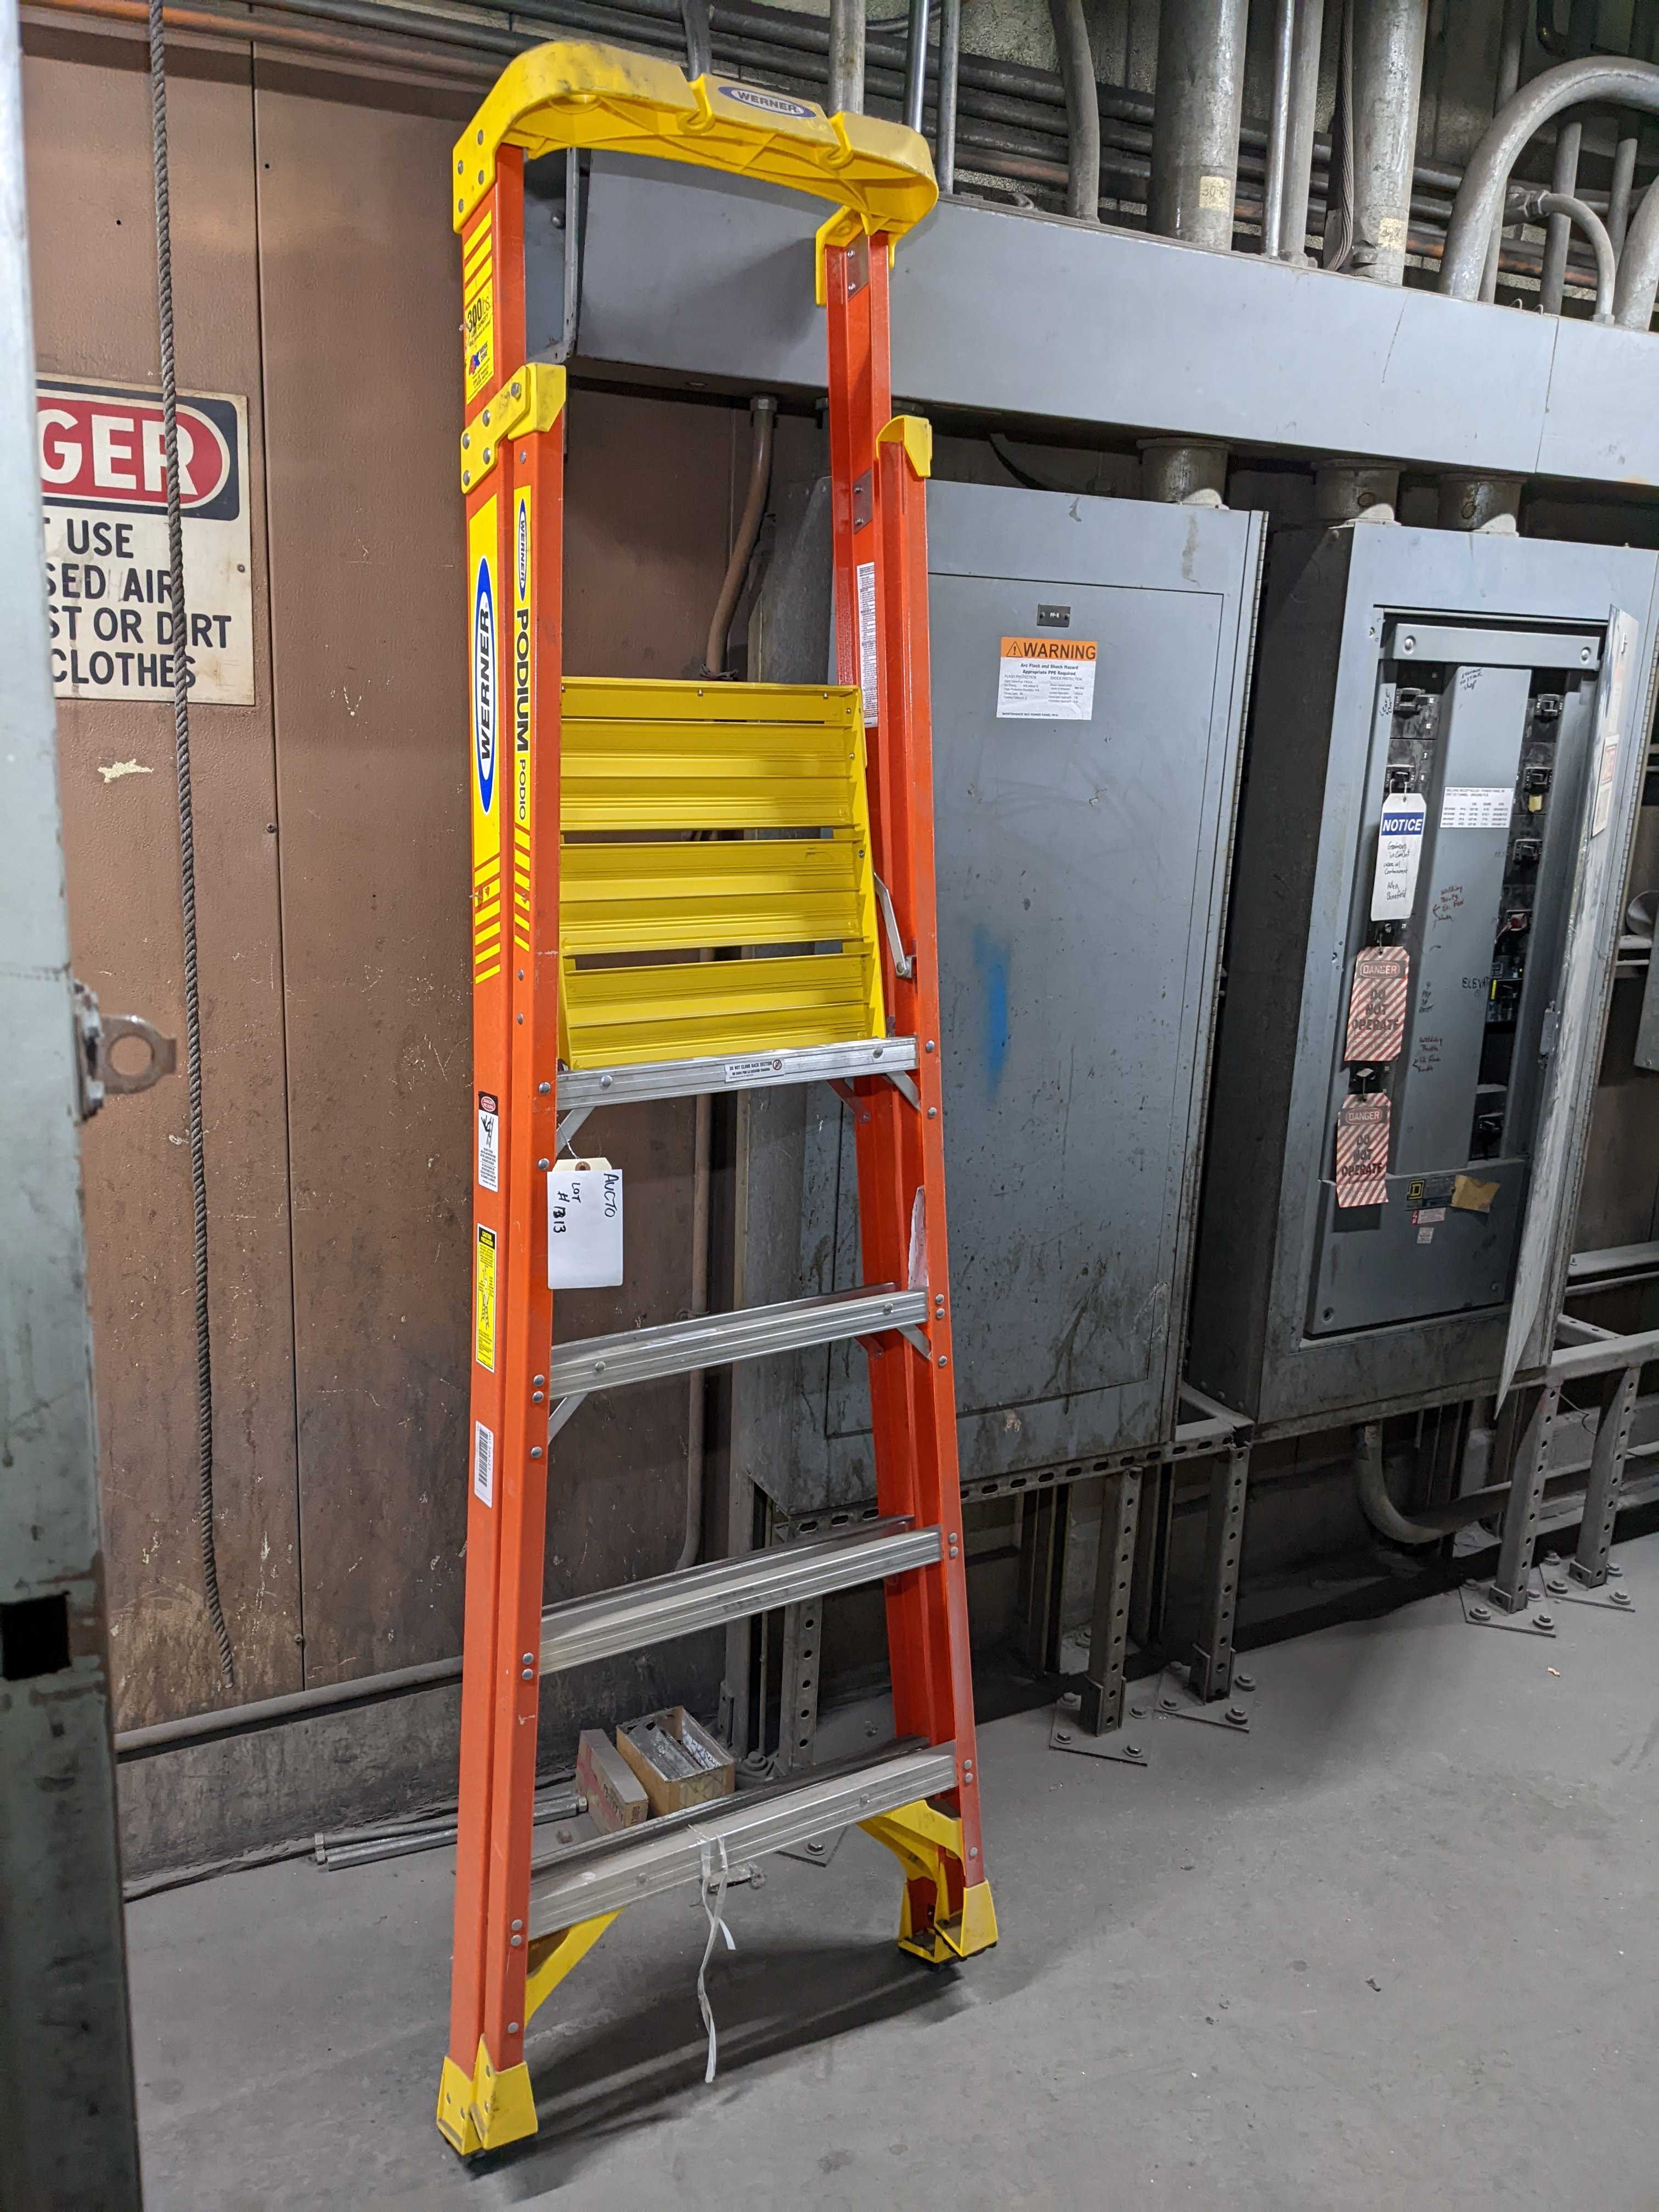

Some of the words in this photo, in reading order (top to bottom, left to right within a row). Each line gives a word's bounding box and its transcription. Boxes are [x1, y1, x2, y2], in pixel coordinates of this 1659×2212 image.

[737, 91, 798, 113] WERNER
[37, 409, 198, 495] GER
[66, 518, 134, 558] USE
[122, 568, 173, 604] AIR
[94, 607, 144, 644] OR
[1023, 642, 1096, 660] WARNING
[478, 608, 490, 760] WERNER
[516, 608, 529, 751] PODIUM
[1383, 819, 1423, 832] NOTICE
[1363, 965, 1397, 974] DANGER
[1370, 989, 1385, 1000] DO
[1365, 1004, 1388, 1015] NOT
[1352, 1018, 1398, 1030] OPERATE
[1348, 1111, 1380, 1121] DANGER
[1357, 1134, 1370, 1146] DO
[1341, 1163, 1382, 1176] OPERATE
[572, 1182, 581, 1203] LOT
